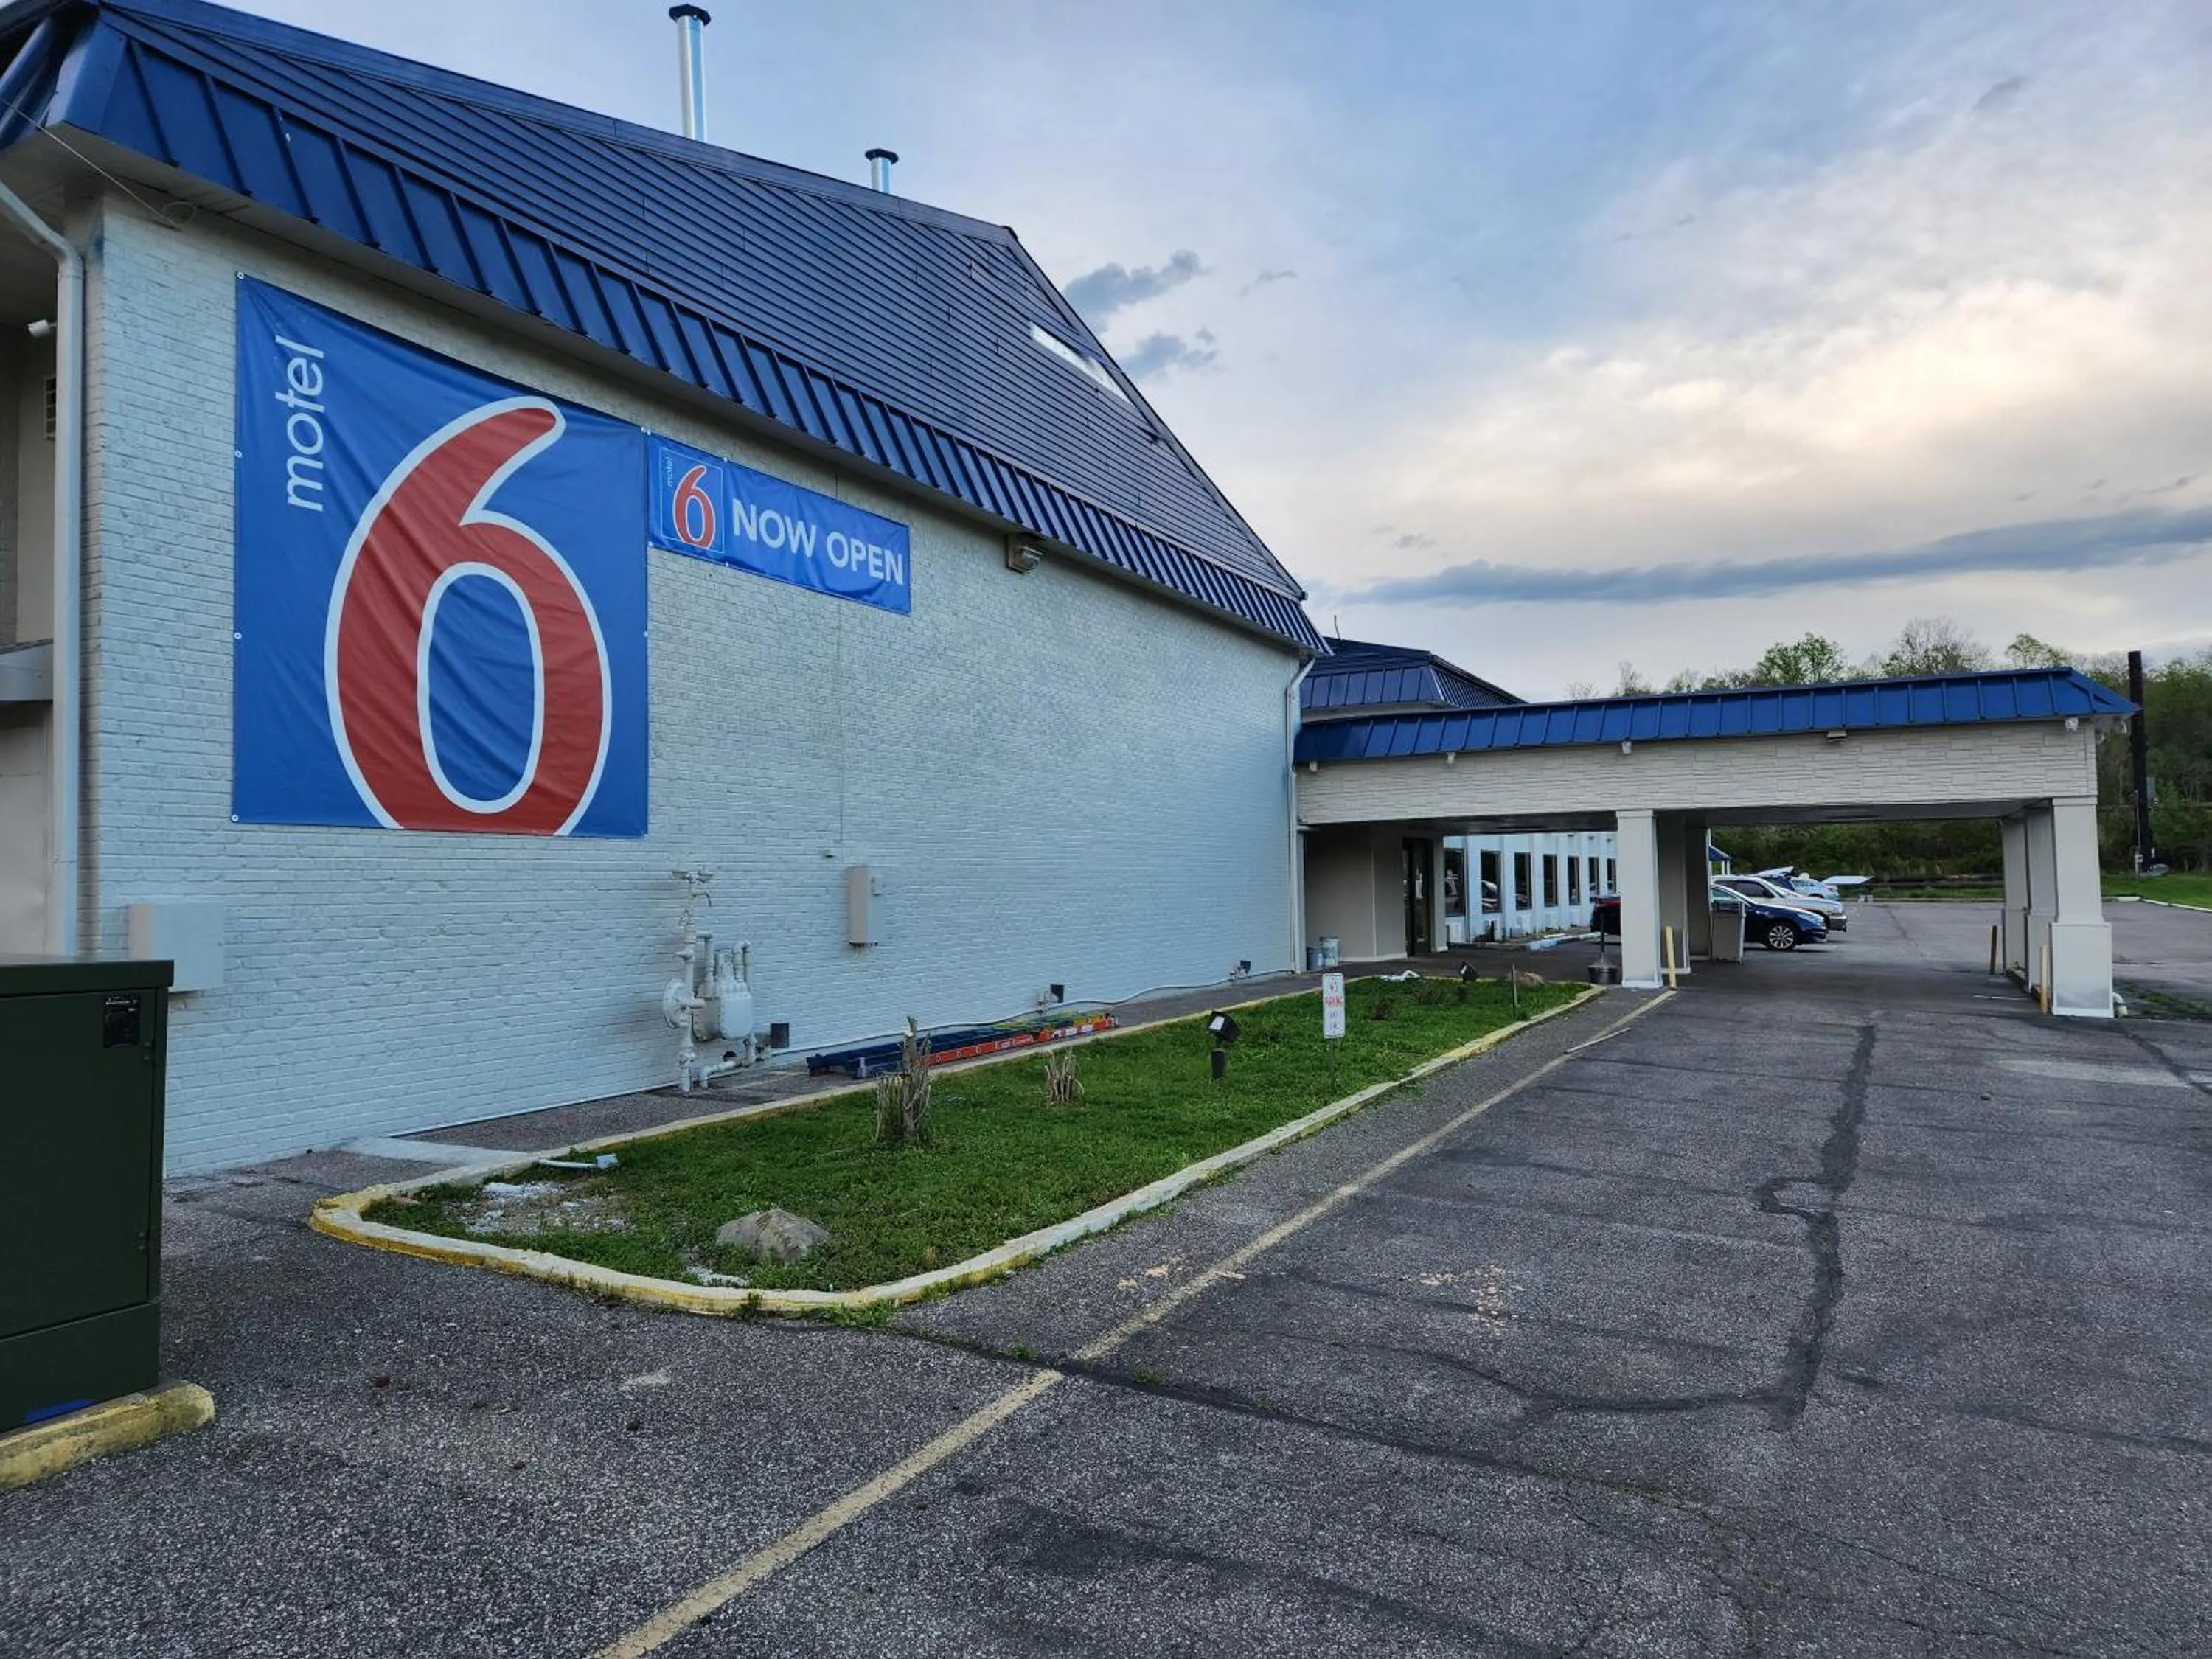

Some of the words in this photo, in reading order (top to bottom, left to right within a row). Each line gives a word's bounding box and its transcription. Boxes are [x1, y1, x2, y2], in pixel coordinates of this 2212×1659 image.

[275, 335, 324, 512] motel
[672, 465, 716, 549] 6
[732, 498, 816, 557] NOW
[826, 531, 903, 585] OPEN
[324, 395, 612, 835] 6
